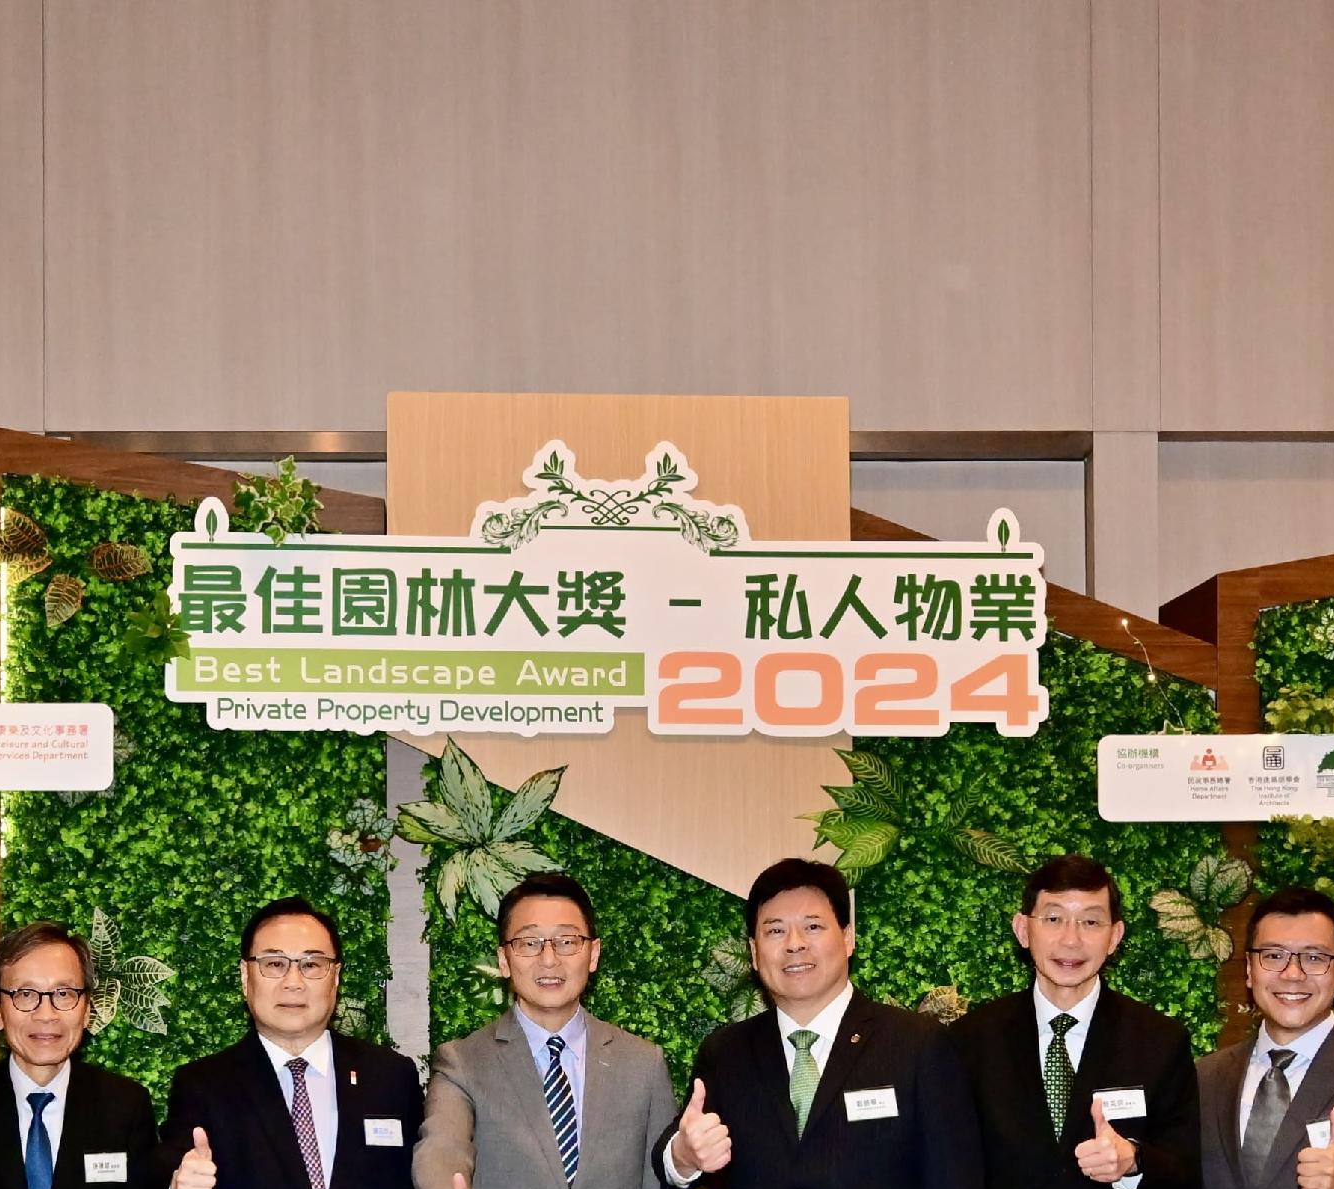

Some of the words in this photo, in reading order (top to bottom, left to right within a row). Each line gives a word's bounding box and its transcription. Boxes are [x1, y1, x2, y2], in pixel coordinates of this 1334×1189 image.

[178, 564, 626, 639] 最佳園林大獎
[669, 598, 702, 607] -
[745, 573, 1037, 642] 私人物業
[194, 655, 281, 684] Best
[301, 656, 496, 690] Landscape
[516, 659, 627, 688] Award
[657, 650, 1039, 727] 2024
[216, 697, 307, 720] Private
[317, 699, 431, 726] Property
[440, 700, 604, 724] Development
[31, 739, 49, 749] and
[51, 739, 88, 749] Cultural
[32, 750, 88, 763] Department
